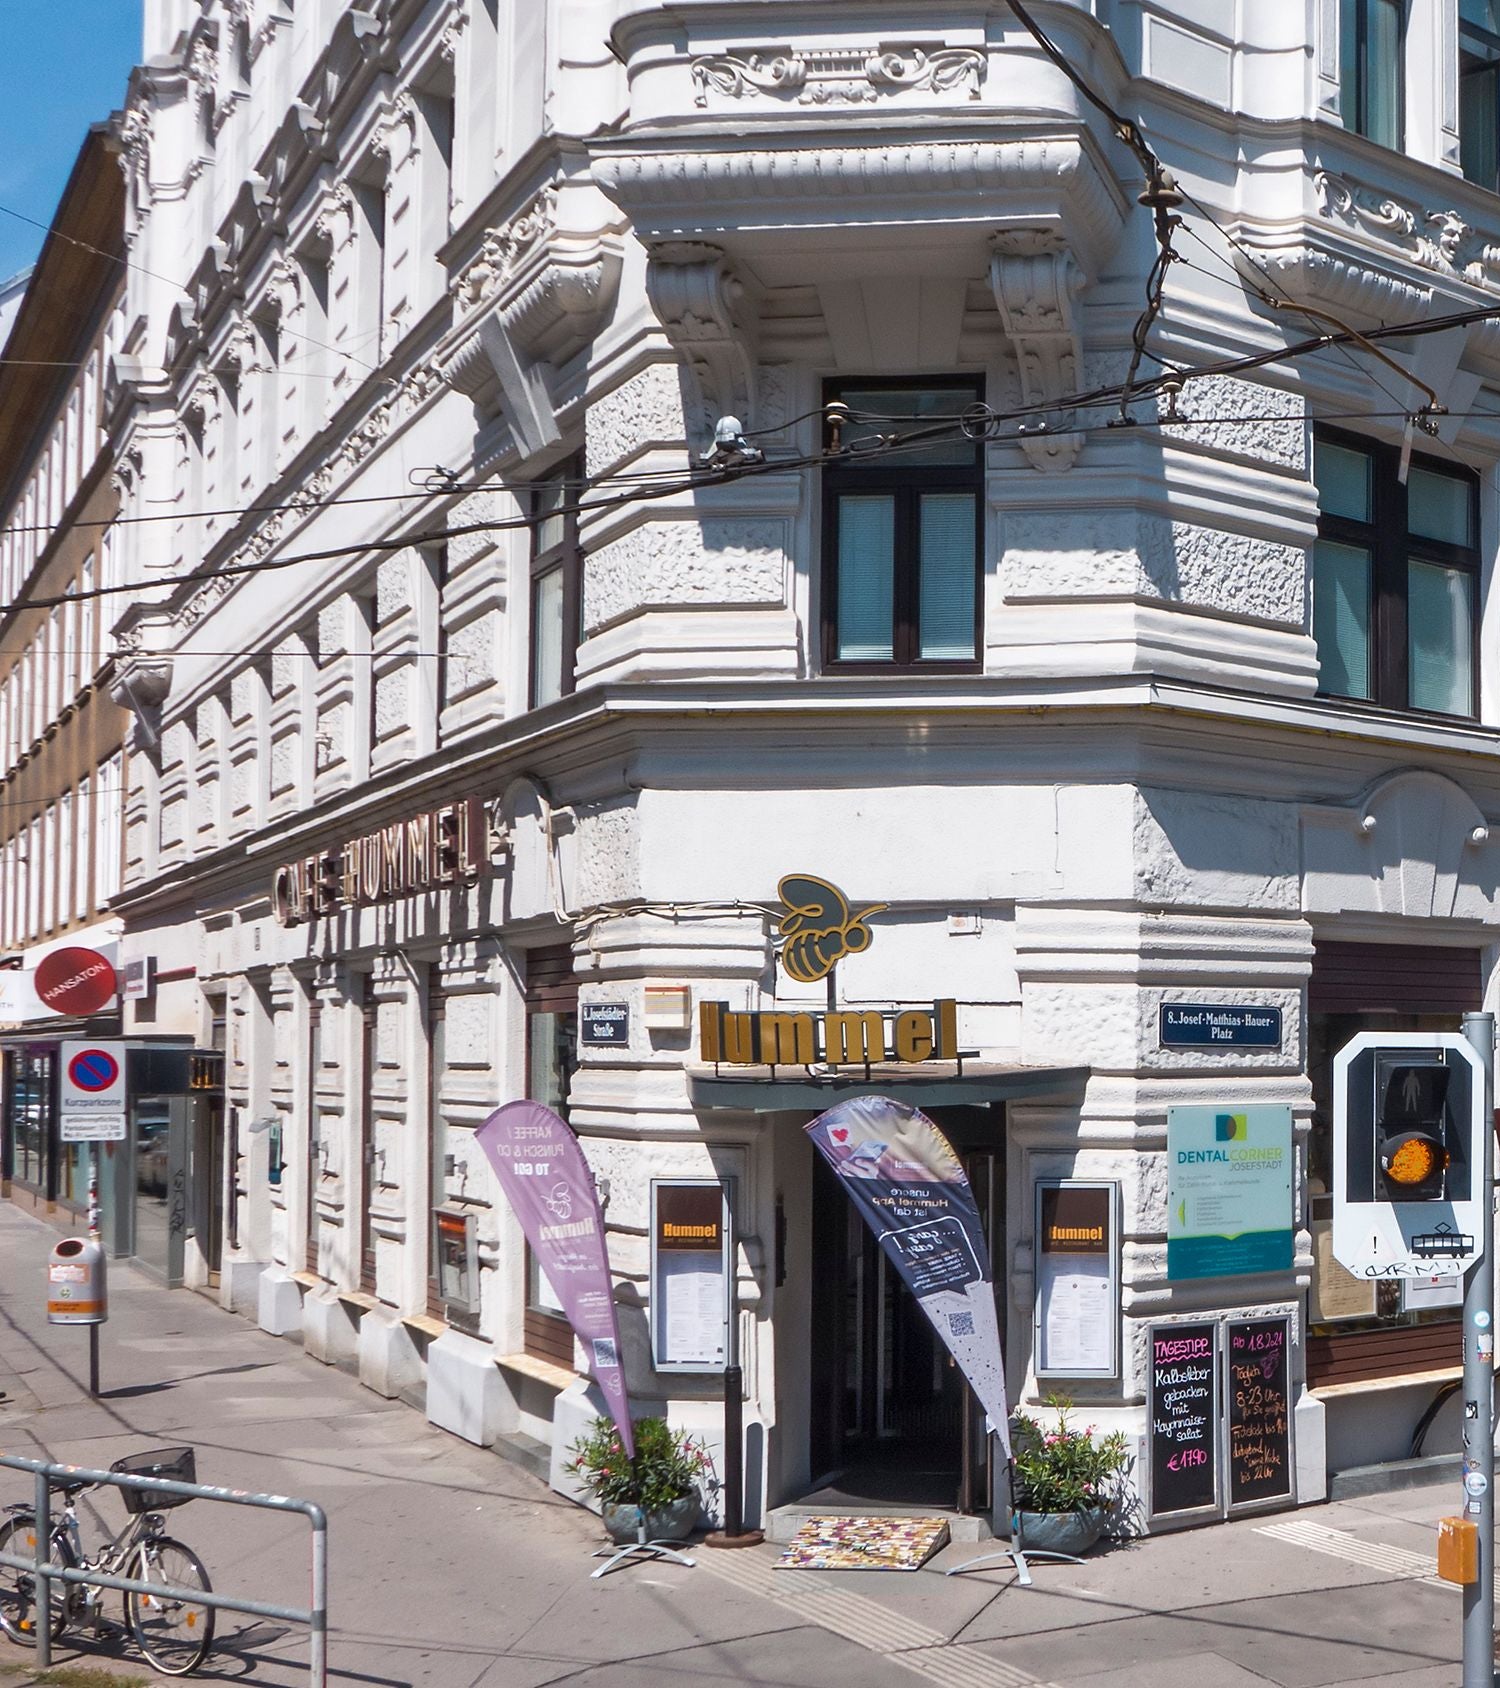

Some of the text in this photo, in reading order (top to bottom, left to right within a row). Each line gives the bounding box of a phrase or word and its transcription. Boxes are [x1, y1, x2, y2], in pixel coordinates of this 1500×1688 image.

[44, 962, 109, 1000] HANSATON
[699, 998, 958, 1064] Hummel
[1211, 1027, 1233, 1039] Platz
[1229, 1160, 1283, 1171] JOSEFSTADT
[663, 1223, 717, 1238] Hummel
[1048, 1226, 1103, 1240] Hummel
[1154, 1338, 1208, 1358] TAGESTIPP
[1233, 1337, 1245, 1348] Ab
[1155, 1366, 1211, 1387] Kalbsleber
[1164, 1387, 1208, 1410] gebacken
[1172, 1402, 1190, 1416] mit
[1176, 1428, 1203, 1442] salat
[1167, 1453, 1181, 1471] €
